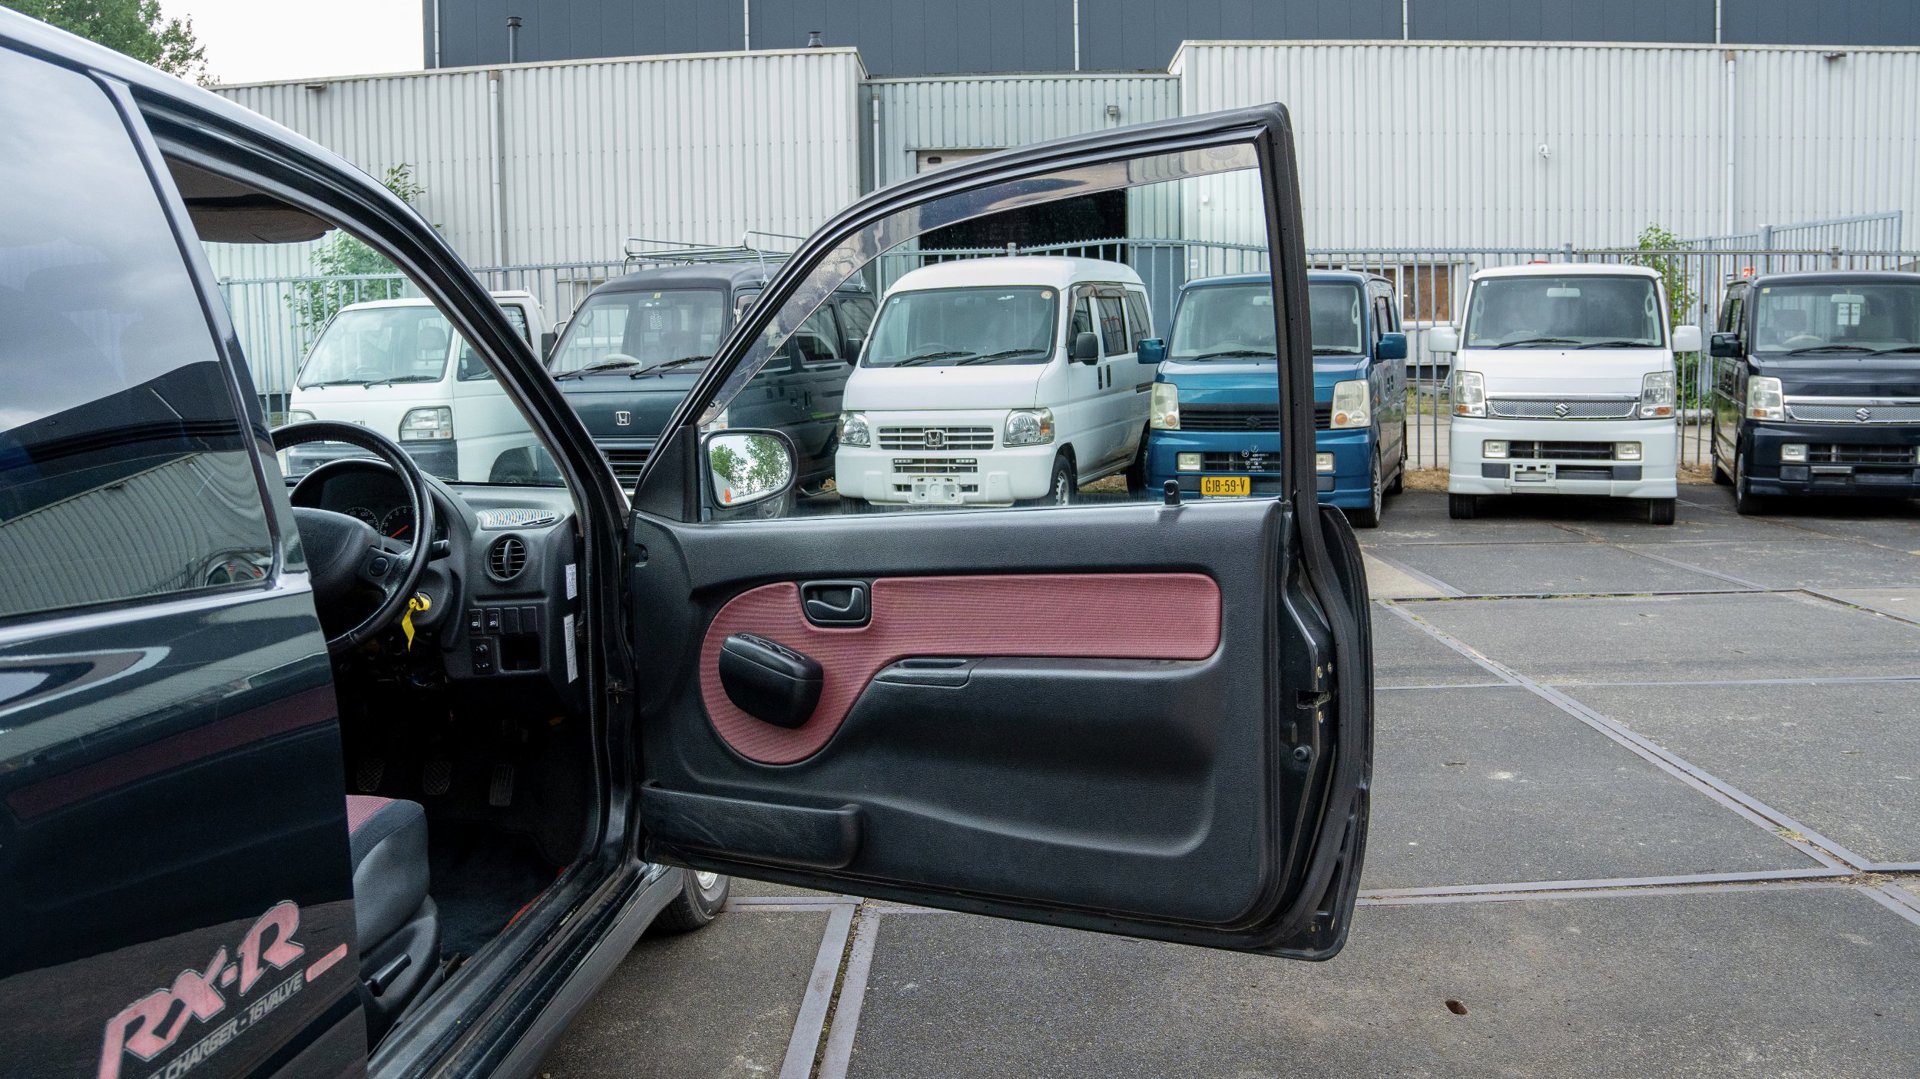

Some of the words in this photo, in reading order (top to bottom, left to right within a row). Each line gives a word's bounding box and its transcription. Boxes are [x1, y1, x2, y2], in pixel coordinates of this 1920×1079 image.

[1205, 478, 1246, 493] GJB-59-V
[97, 899, 304, 1079] RX-R
[163, 1018, 239, 1079] CHARGER
[247, 973, 304, 1027] 16VALVE
